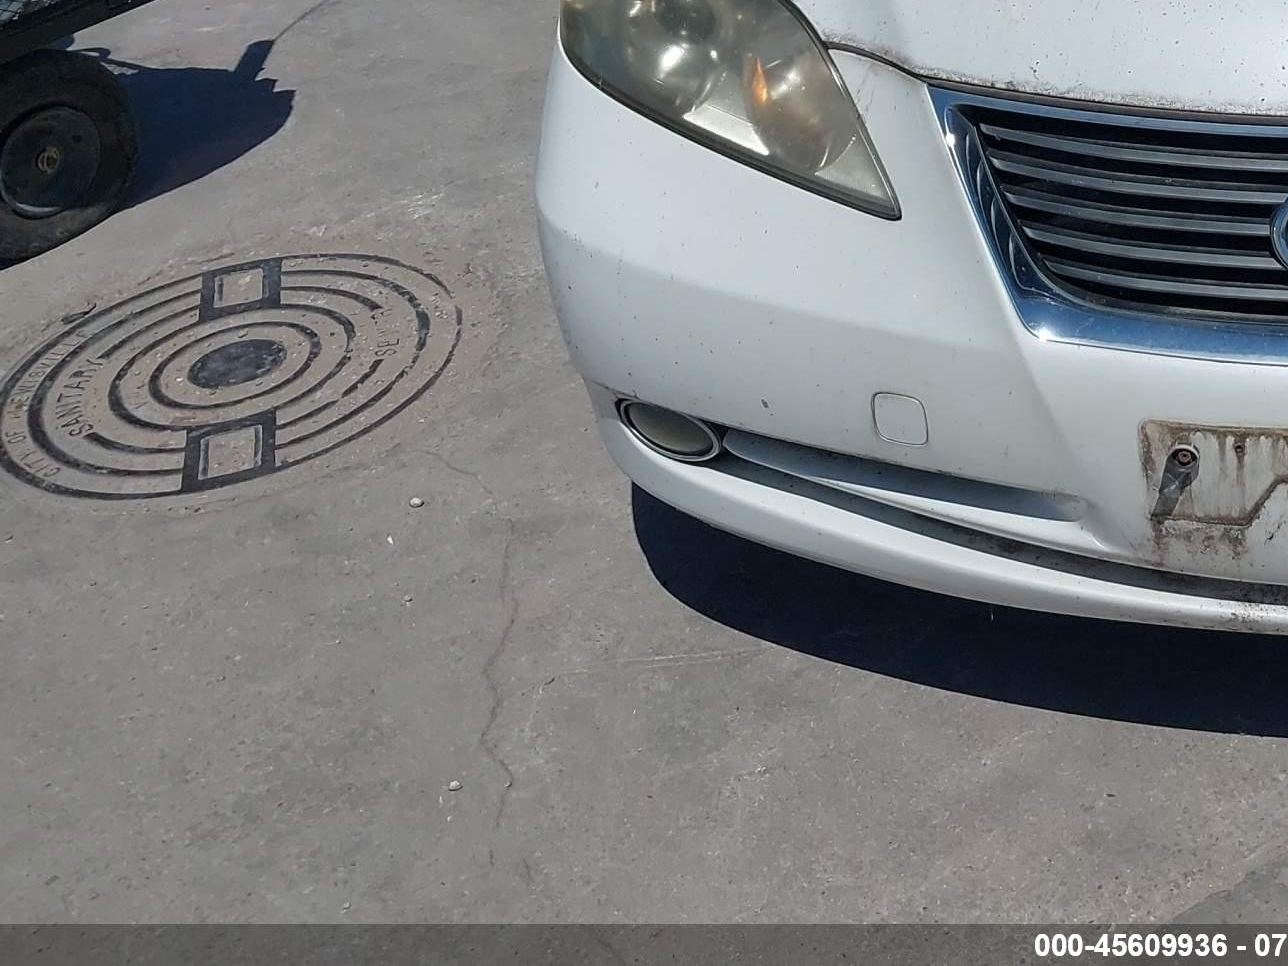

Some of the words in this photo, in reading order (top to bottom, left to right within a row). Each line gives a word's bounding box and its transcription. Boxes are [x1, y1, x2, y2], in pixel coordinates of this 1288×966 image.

[56, 357, 103, 438] SANITARY
[5, 430, 27, 445] OF
[19, 449, 61, 478] CITY
